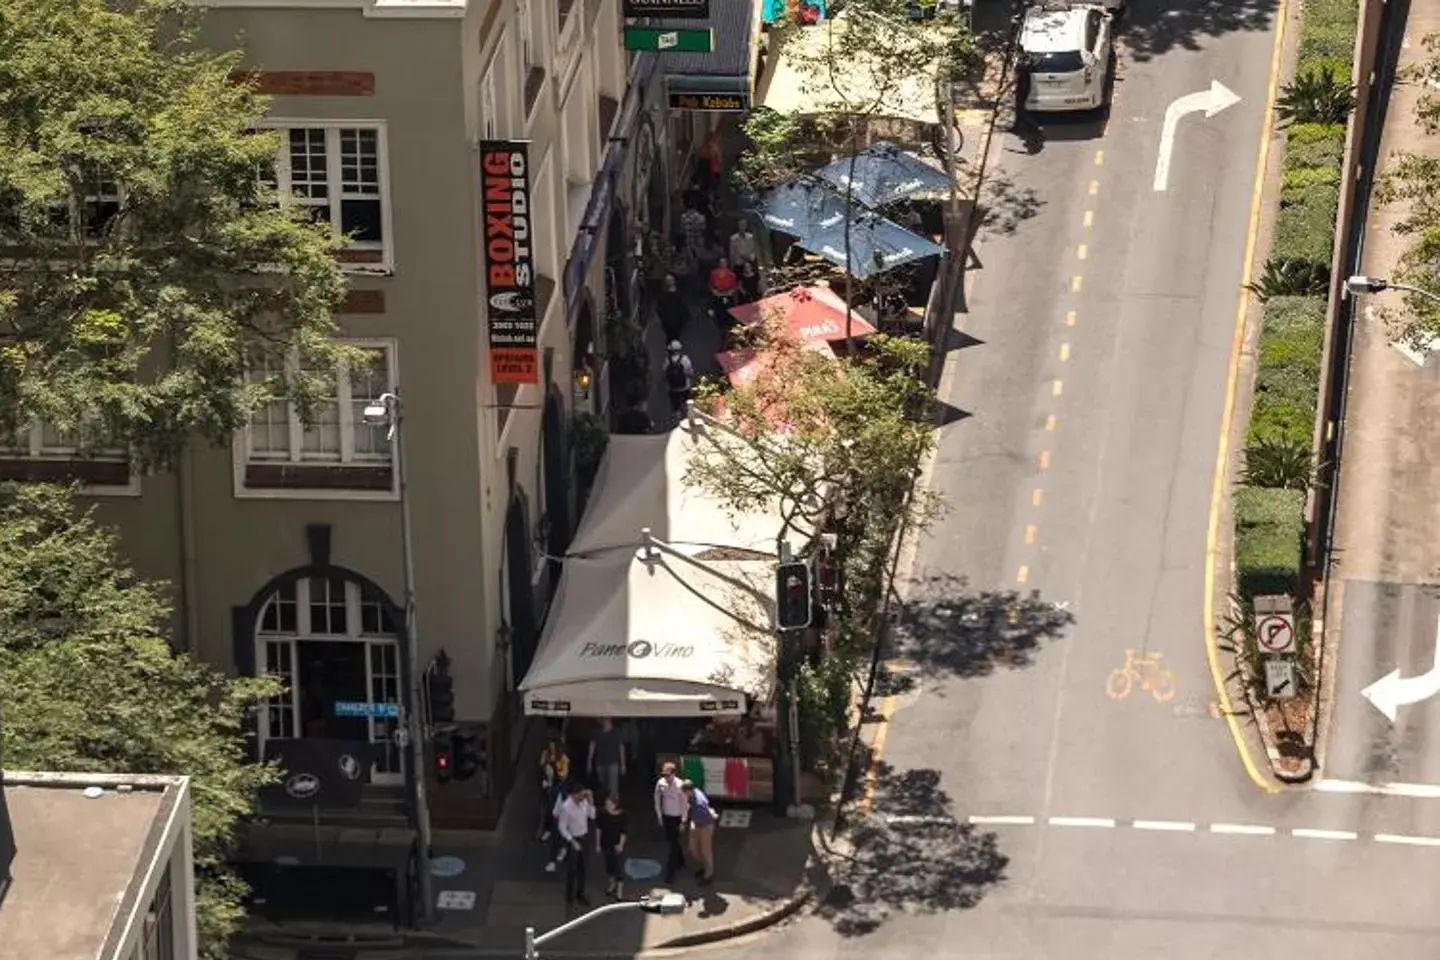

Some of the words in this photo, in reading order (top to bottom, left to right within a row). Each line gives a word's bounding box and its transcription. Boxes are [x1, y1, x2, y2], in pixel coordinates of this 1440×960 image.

[483, 152, 515, 287] BOXING
[510, 152, 530, 287] STUDIO
[579, 642, 626, 658] Pane
[654, 642, 695, 658] Vino
